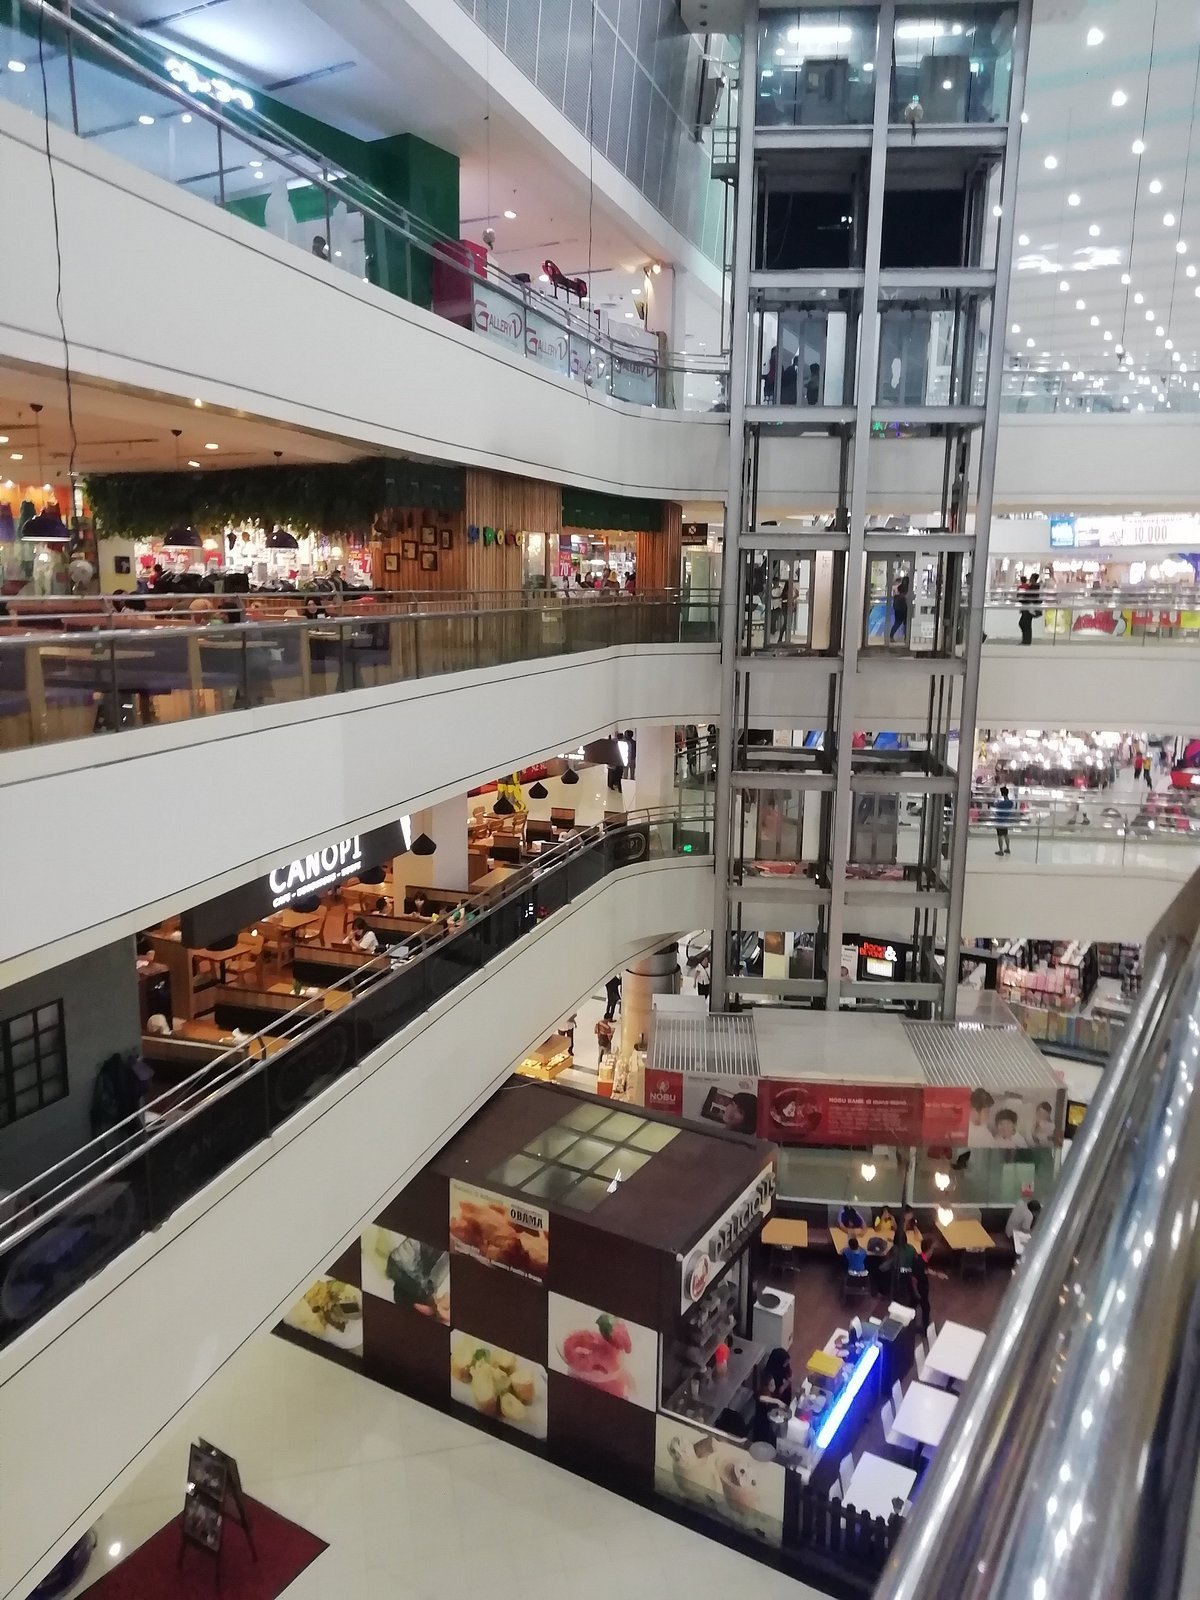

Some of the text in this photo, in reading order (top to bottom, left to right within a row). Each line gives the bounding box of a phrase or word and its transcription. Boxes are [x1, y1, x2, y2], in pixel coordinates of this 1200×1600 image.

[269, 834, 362, 894] CANOPI
[649, 1091, 676, 1102] NOBU
[510, 1208, 544, 1229] OBAMA
